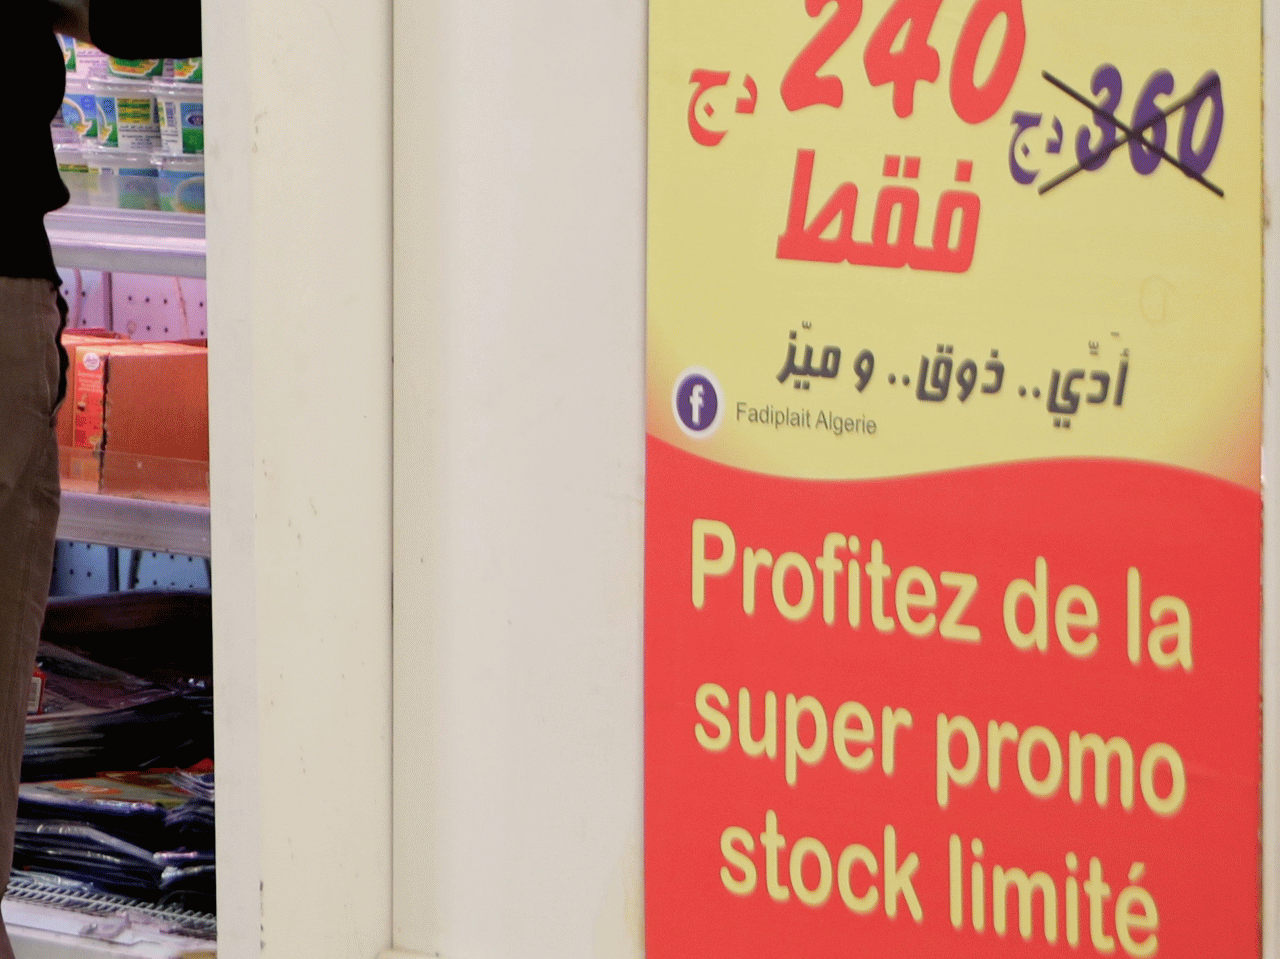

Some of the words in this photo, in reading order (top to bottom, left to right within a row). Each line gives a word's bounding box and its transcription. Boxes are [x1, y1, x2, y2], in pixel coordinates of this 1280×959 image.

[1075, 62, 1225, 176] 360
[776, 148, 981, 274] فقط
[735, 401, 811, 430] Fadiplait
[815, 408, 878, 436] Algerie
[852, 348, 876, 393] و
[691, 518, 981, 644] Profitez
[1002, 556, 1099, 658] de
[1126, 566, 1194, 672] la
[694, 682, 913, 786] super
[936, 712, 1187, 816] promo
[720, 809, 923, 924] stock
[948, 833, 1160, 958] limité
